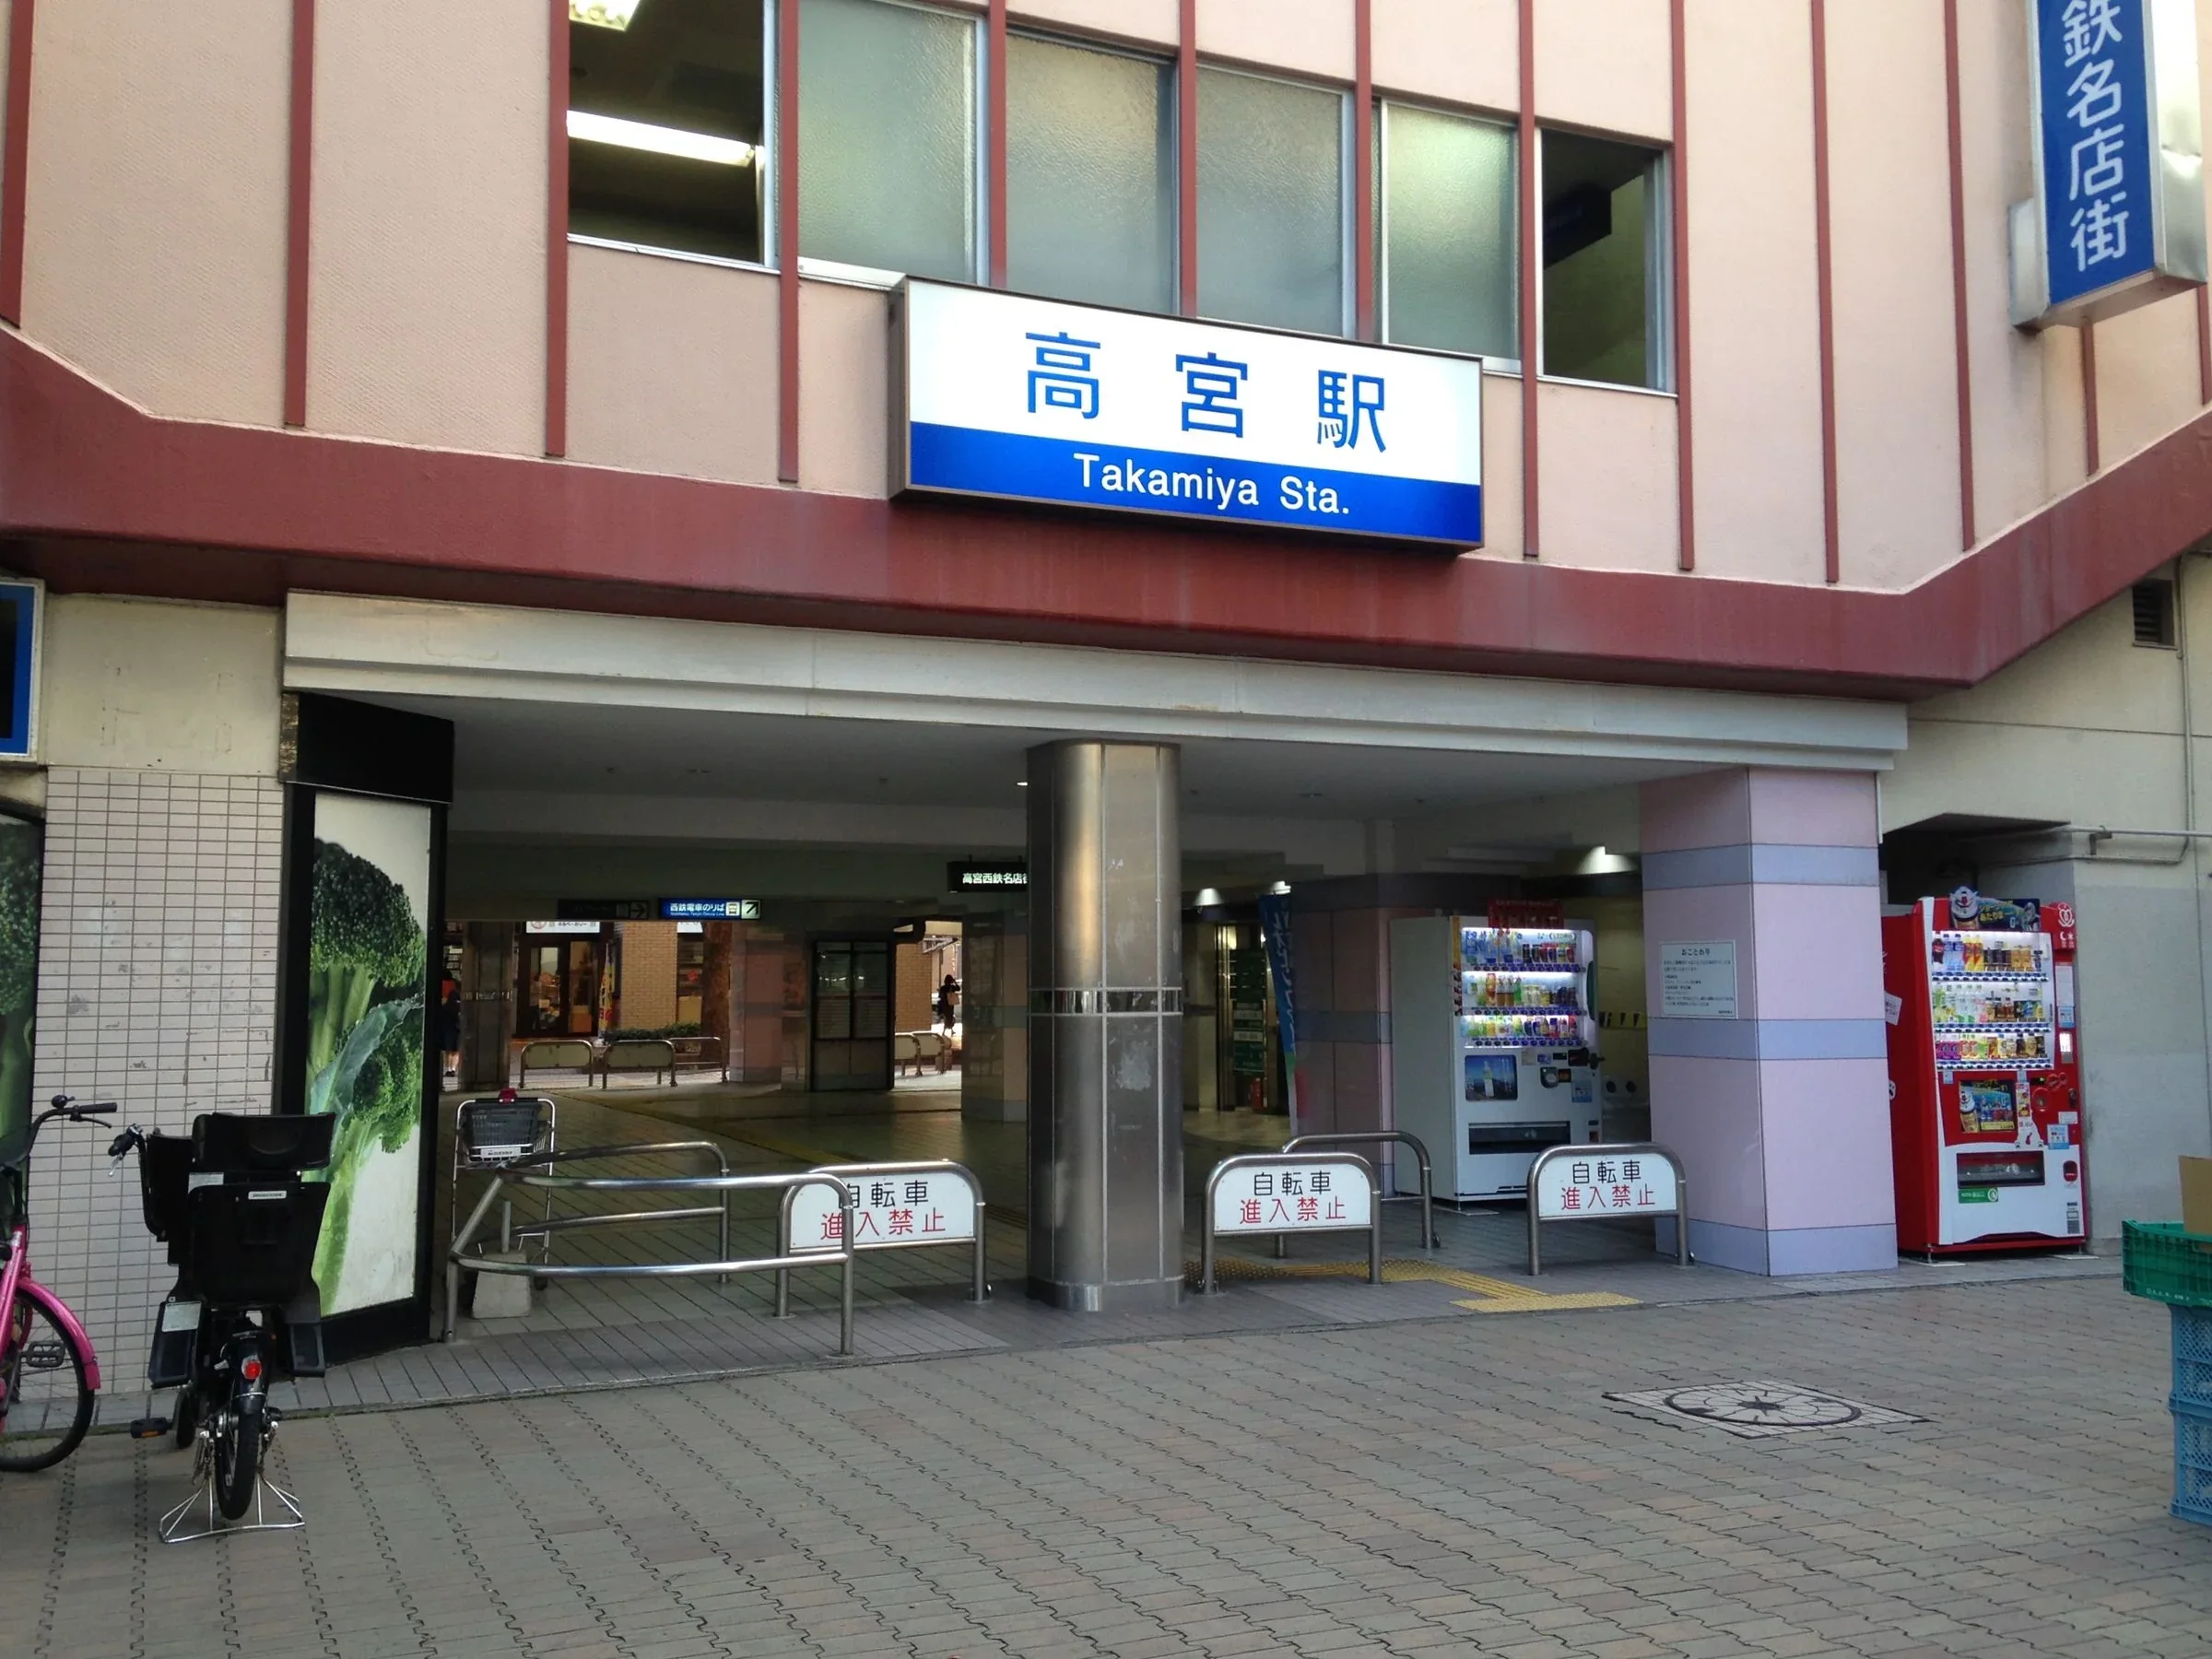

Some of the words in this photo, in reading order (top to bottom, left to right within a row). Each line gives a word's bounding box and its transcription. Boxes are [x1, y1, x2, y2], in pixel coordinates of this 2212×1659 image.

[2062, 0, 2129, 272] 鉄名店街
[1025, 331, 1387, 453] 高宮駅
[1074, 453, 1259, 510] Takamiya
[1279, 475, 1349, 514] Sta.
[670, 903, 724, 912] 西鉄電車のりば
[1254, 1171, 1331, 1195] 自転車
[1572, 1159, 1641, 1184] 自転車
[1240, 1195, 1347, 1224] 進入禁止
[1560, 1183, 1655, 1210] 進入禁止
[820, 1206, 946, 1241] 進入禁止
